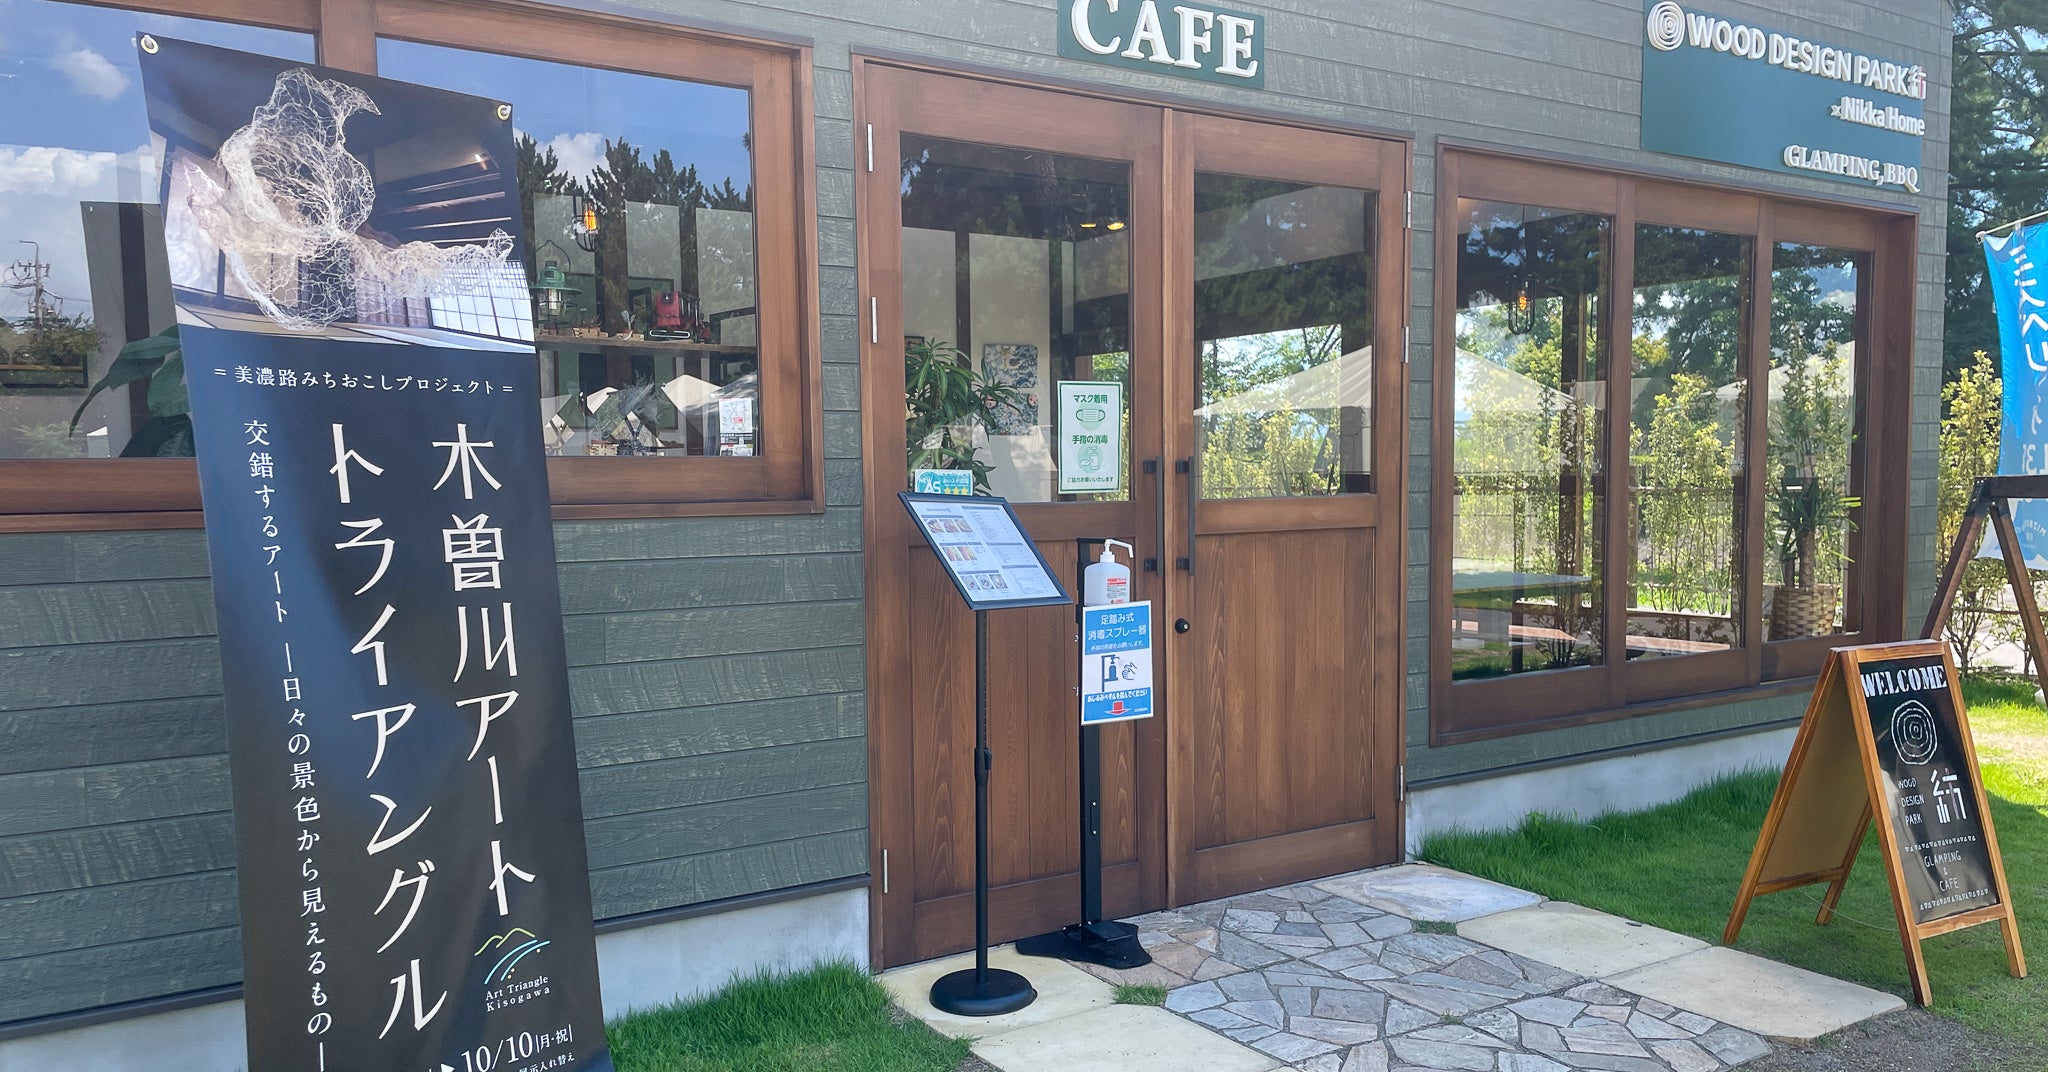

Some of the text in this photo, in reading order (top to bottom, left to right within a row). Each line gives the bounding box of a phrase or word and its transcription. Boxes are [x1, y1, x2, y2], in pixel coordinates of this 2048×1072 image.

[1071, 0, 1259, 78] CAFE
[1687, 13, 1766, 60] WOOD
[1769, 33, 1852, 82] DESIGN
[1854, 55, 1909, 96] PARK
[1841, 96, 1885, 127] Nikka
[1884, 106, 1925, 136] Home
[1073, 394, 1108, 404] マスク着用
[1072, 434, 1108, 445] 手指の消毒
[243, 419, 288, 623] 交錯するアート
[1100, 612, 1135, 626] 足踏み式
[1087, 624, 1147, 641] 消毒スプレー器
[432, 423, 536, 916] 木曽川アート
[1861, 665, 1948, 698] WELCOME
[329, 423, 448, 1039] トライアングル
[1898, 777, 1917, 789] WOOD
[1900, 793, 1925, 808] DESIGN
[1905, 812, 1923, 827] PARK
[1924, 850, 1962, 868] GLAMPING
[1939, 877, 1960, 892] CAFE
[485, 975, 549, 1001] Art Triangle
[486, 987, 550, 1013] Kisogawa
[461, 1031, 533, 1072] 10/10
